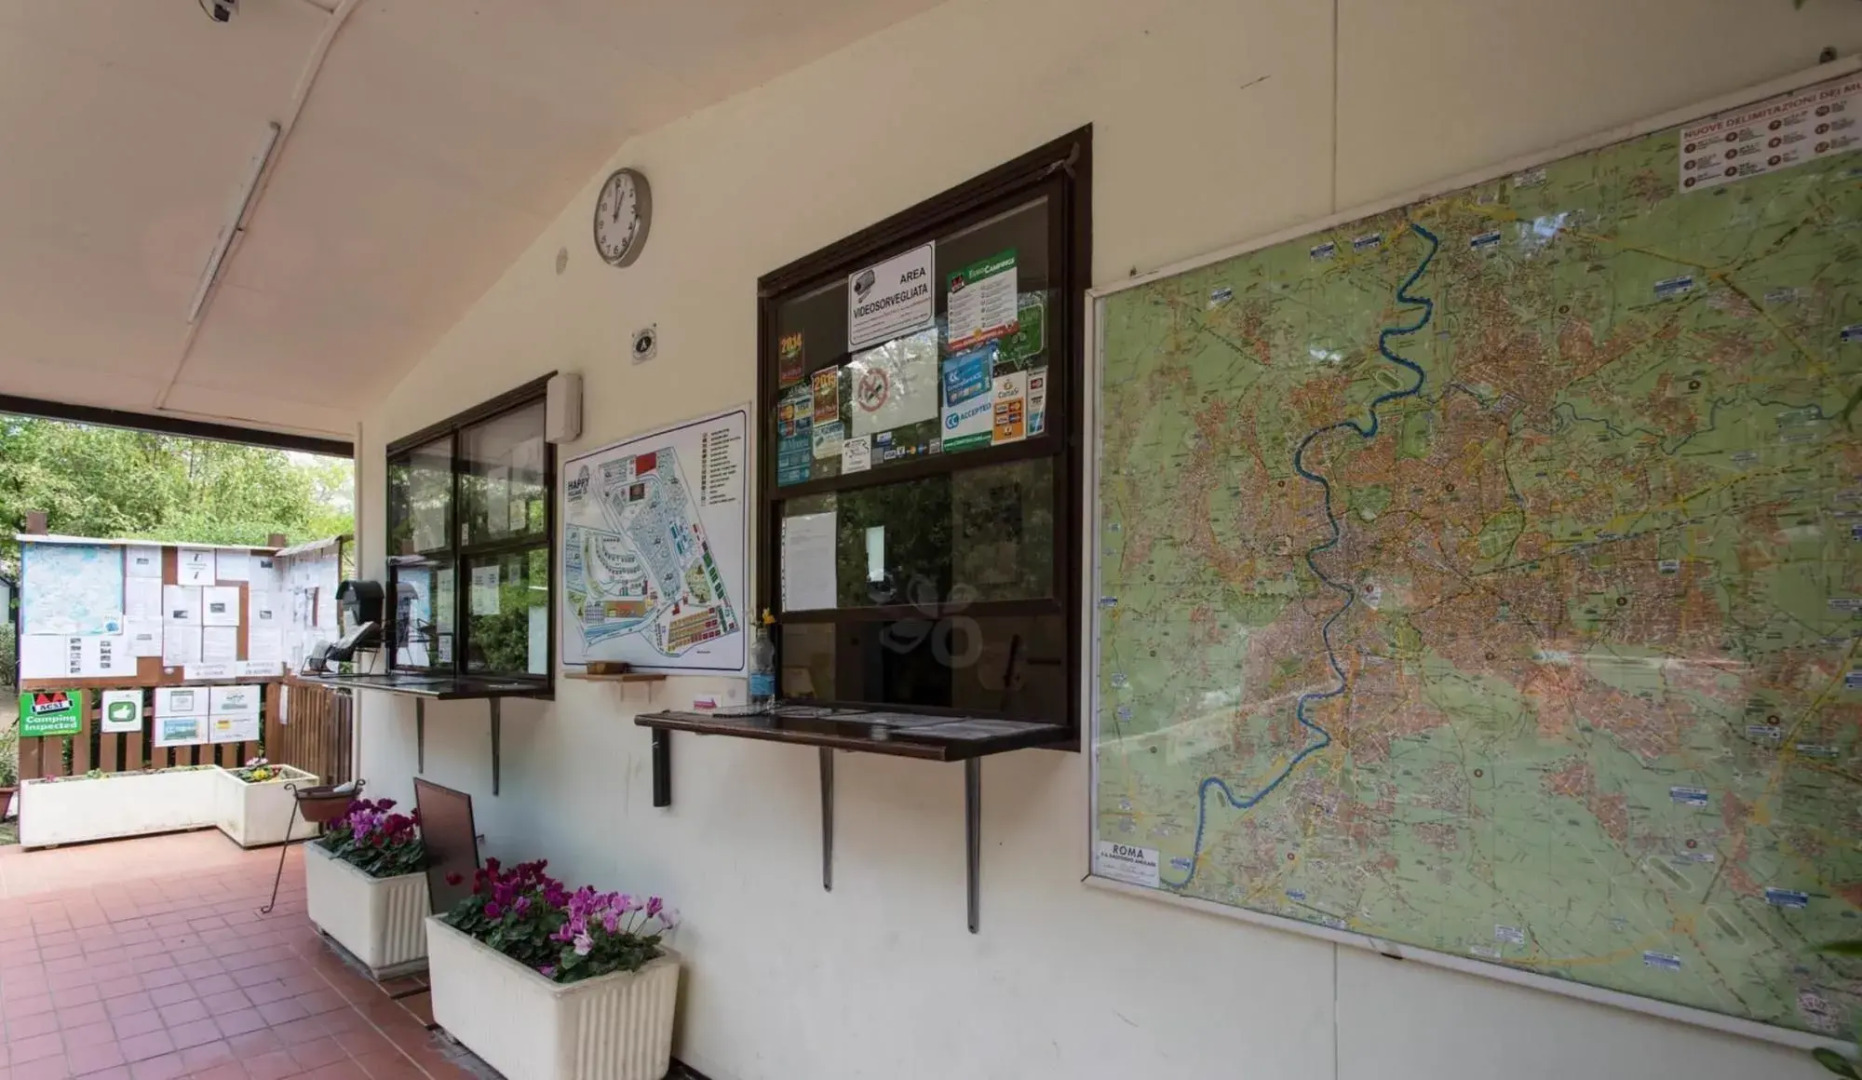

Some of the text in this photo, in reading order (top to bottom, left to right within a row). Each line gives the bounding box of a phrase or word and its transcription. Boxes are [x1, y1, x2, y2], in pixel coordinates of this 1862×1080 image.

[1683, 122, 1723, 139] NUOVE
[1725, 95, 1817, 127] DELIMITAZIONI
[899, 266, 927, 285] AREA
[852, 283, 929, 319] VIDEOSORVEGLIATA
[960, 402, 992, 421] ACCEPTED
[567, 477, 589, 491] HAPPY
[40, 702, 64, 711] ACSI
[25, 721, 77, 731] Inspected
[26, 714, 77, 724] Camping
[1112, 844, 1145, 859] ROMA
